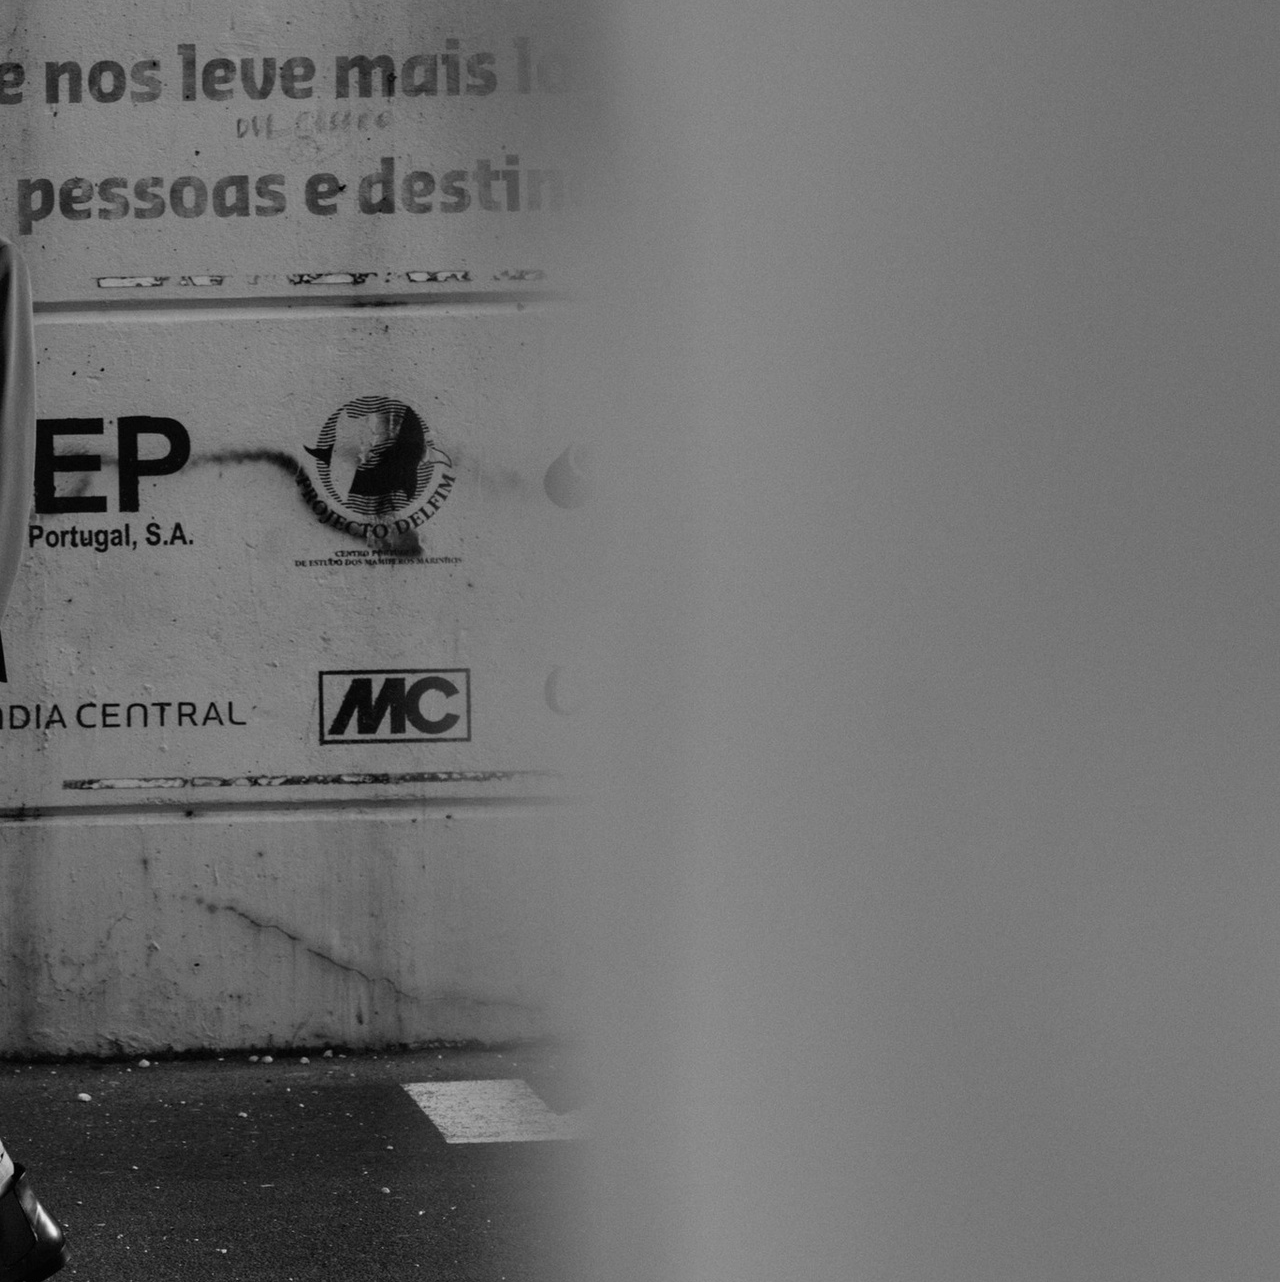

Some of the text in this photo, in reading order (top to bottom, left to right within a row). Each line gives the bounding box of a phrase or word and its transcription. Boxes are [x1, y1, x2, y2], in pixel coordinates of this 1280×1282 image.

[45, 59, 161, 105] nos
[177, 43, 316, 102] leve
[336, 38, 497, 99] mais
[17, 174, 287, 237] pessoas
[305, 173, 348, 216] e
[33, 414, 191, 515] EP
[296, 469, 457, 539] PROJECTO DELFIM
[28, 521, 194, 553] Portugal, S.A.
[334, 549, 370, 558] CENTRO
[294, 559, 308, 568] DE
[308, 557, 344, 567] ESTUDO
[344, 558, 363, 567] DOS
[75, 700, 248, 730] CENTRAL
